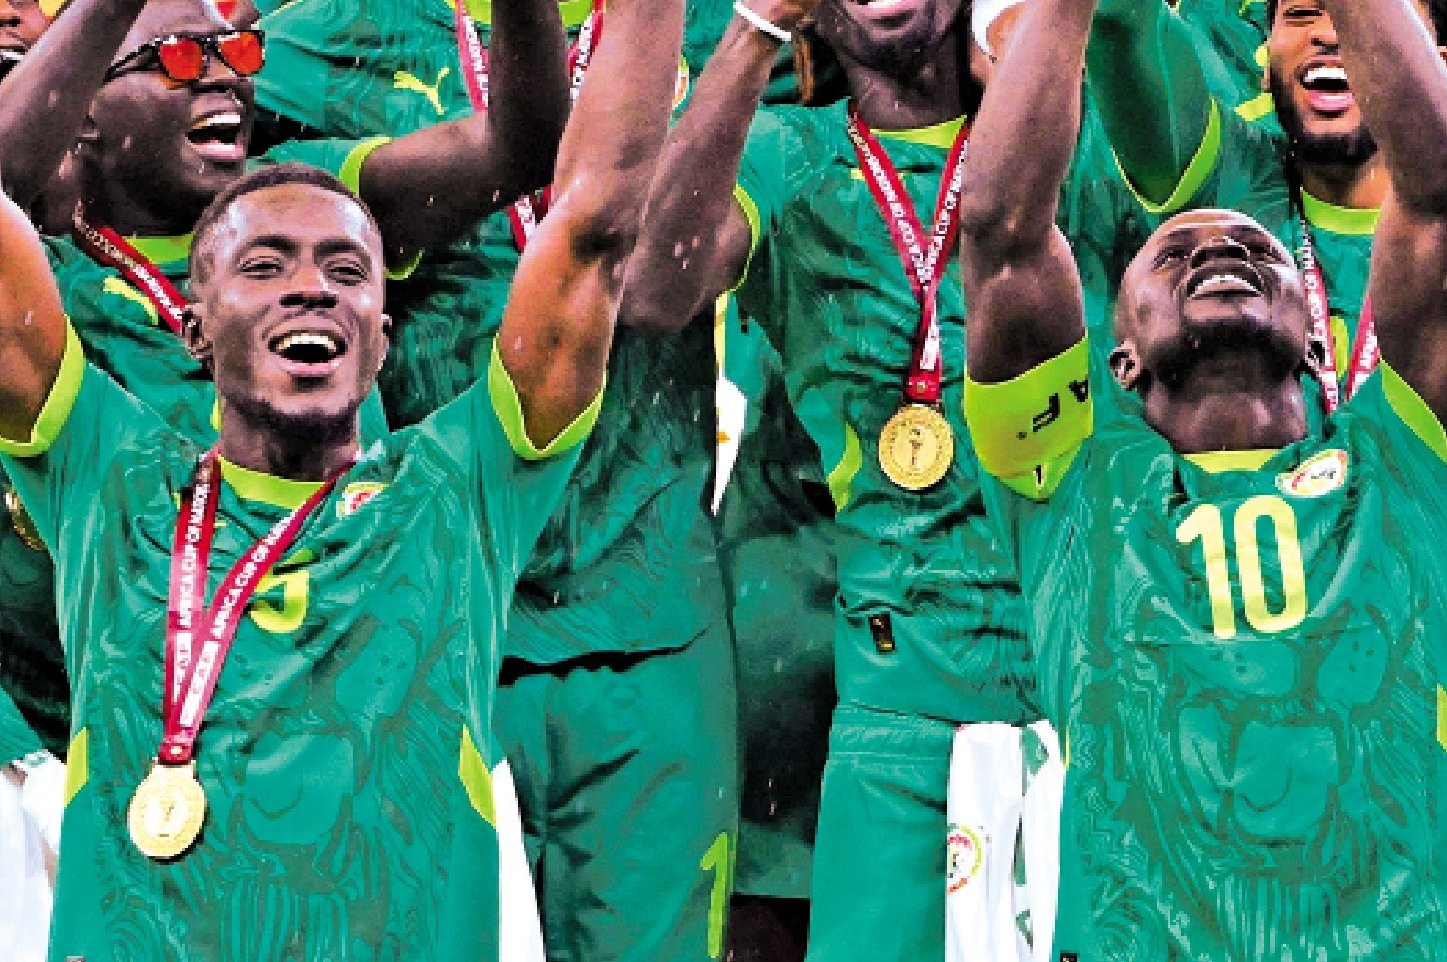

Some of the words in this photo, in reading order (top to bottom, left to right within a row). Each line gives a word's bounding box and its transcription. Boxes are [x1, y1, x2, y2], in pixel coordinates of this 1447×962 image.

[1033, 374, 1089, 433] AF
[181, 544, 200, 571] CUP
[186, 525, 202, 543] OF
[210, 588, 244, 639] AFRICA
[234, 561, 258, 587] CUP
[250, 544, 271, 563] OF
[1176, 495, 1307, 639] 10
[177, 575, 194, 628] AFRICA
